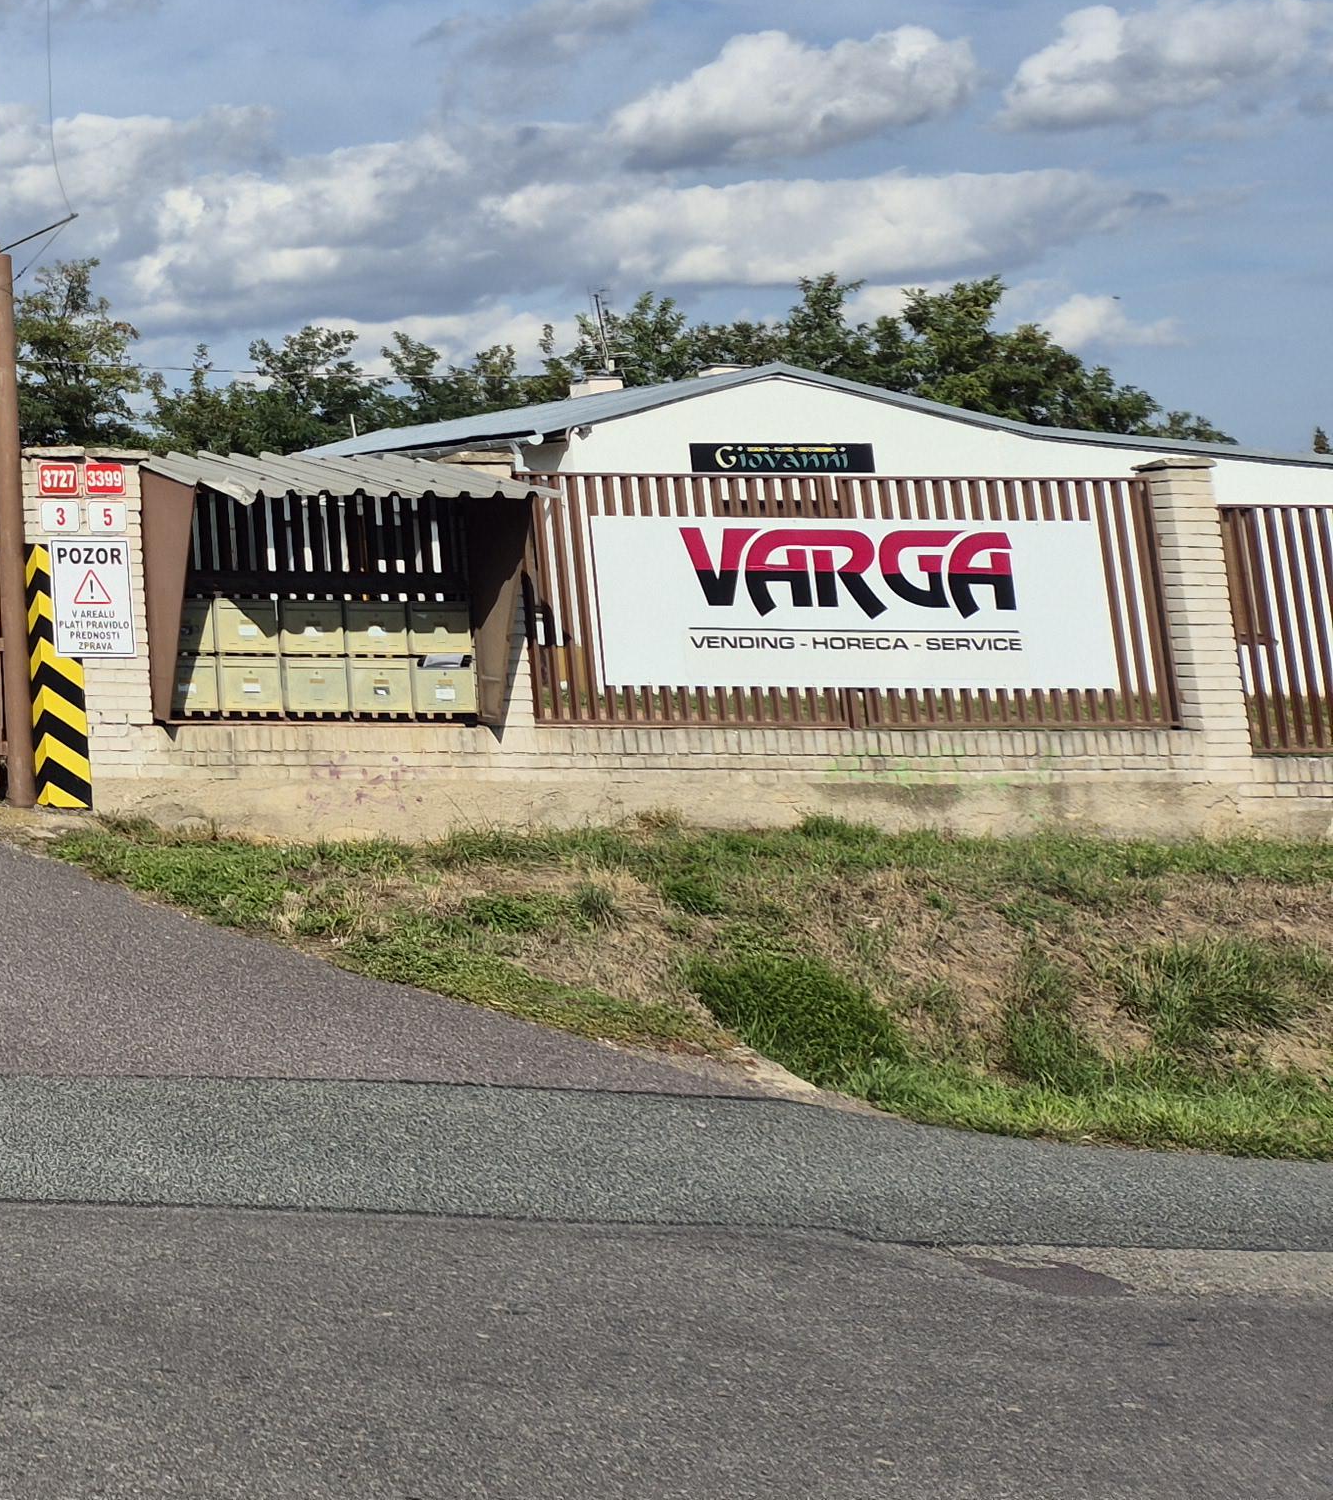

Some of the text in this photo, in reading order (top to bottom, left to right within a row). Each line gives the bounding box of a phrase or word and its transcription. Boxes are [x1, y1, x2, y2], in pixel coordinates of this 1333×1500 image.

[714, 445, 849, 469] Giovanni
[41, 469, 75, 489] 3727
[87, 470, 122, 488] 3399
[56, 507, 66, 526] 3
[103, 508, 113, 527] 5
[57, 547, 123, 565] POZOR
[679, 527, 1018, 619] VARGA
[71, 609, 78, 618] V
[86, 620, 130, 630] PRAVIDLO
[690, 635, 1023, 652] VENDING HORECA SERVICE
